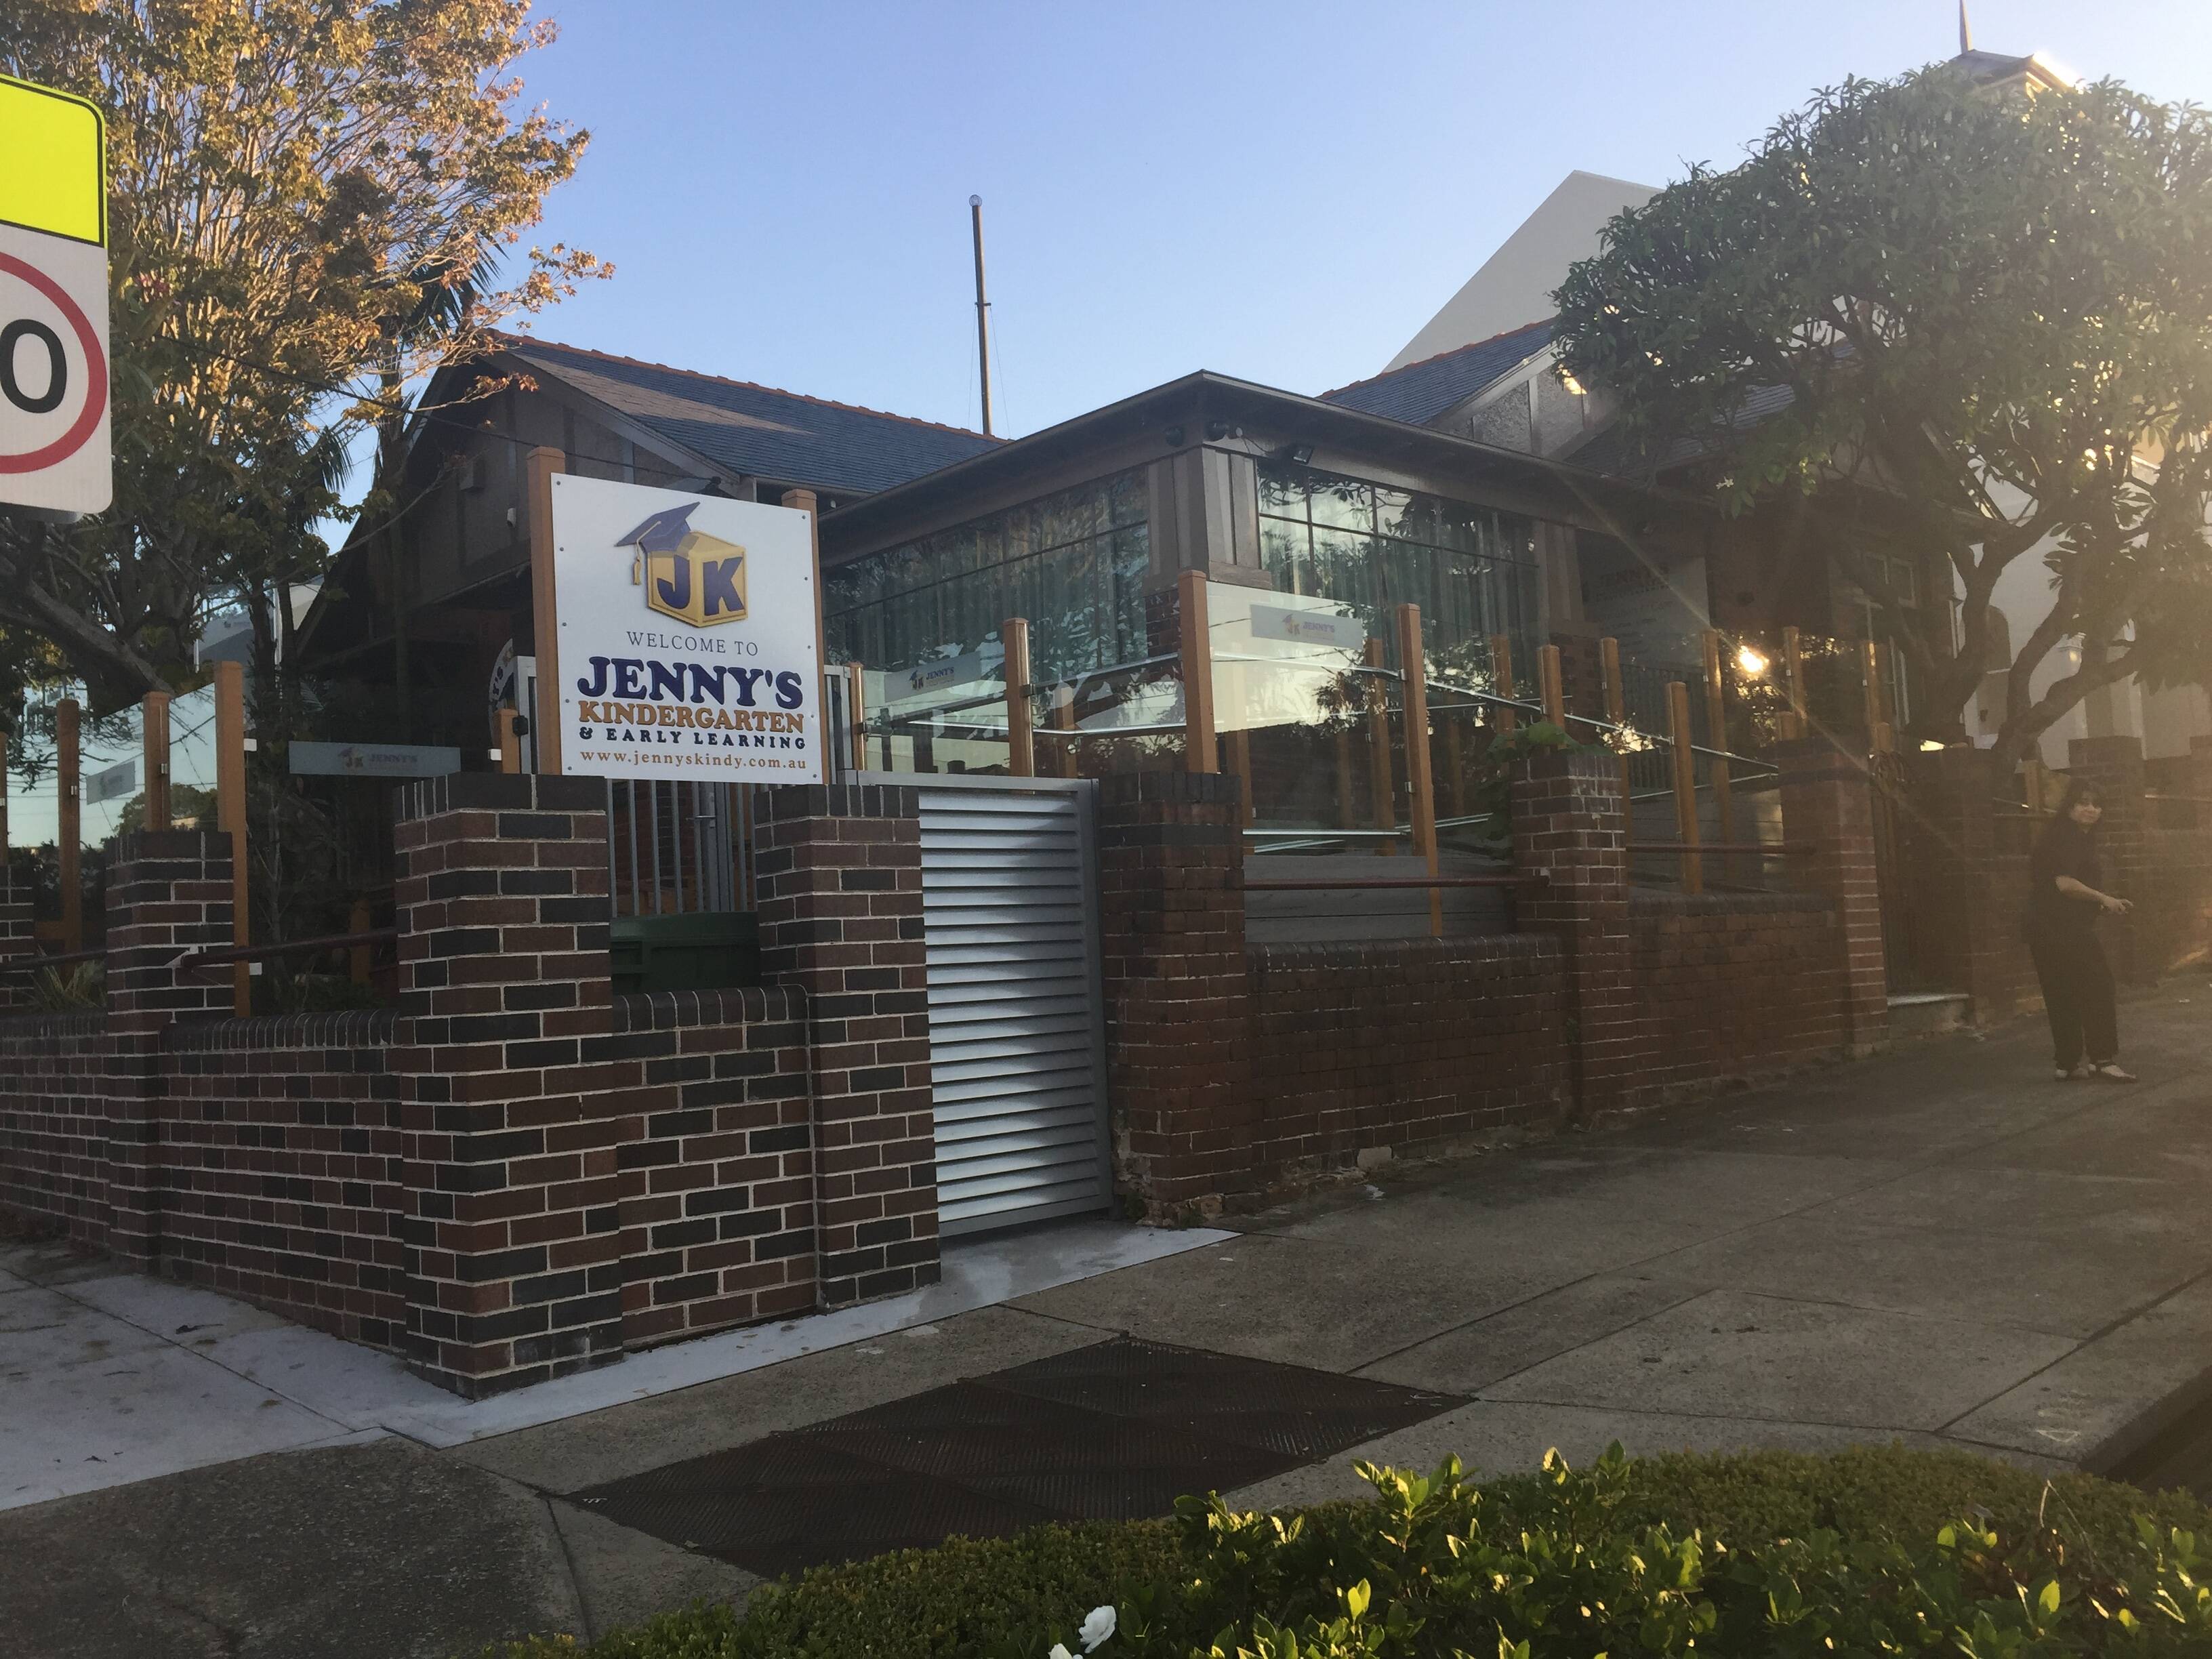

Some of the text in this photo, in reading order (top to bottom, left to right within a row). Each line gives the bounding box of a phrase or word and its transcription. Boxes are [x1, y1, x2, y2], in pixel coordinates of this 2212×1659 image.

[0, 319, 67, 413] 0
[657, 555, 745, 616] JK
[626, 631, 758, 657] WELCOME TO
[577, 656, 803, 709] JENNY'S
[926, 666, 954, 680] JENNY'S
[578, 700, 804, 733] KINDERGARTEN
[579, 727, 806, 750] & EARLY LEARNING
[369, 753, 418, 764] JENNY'S
[580, 750, 806, 770] www.jennyskindy.com.au
